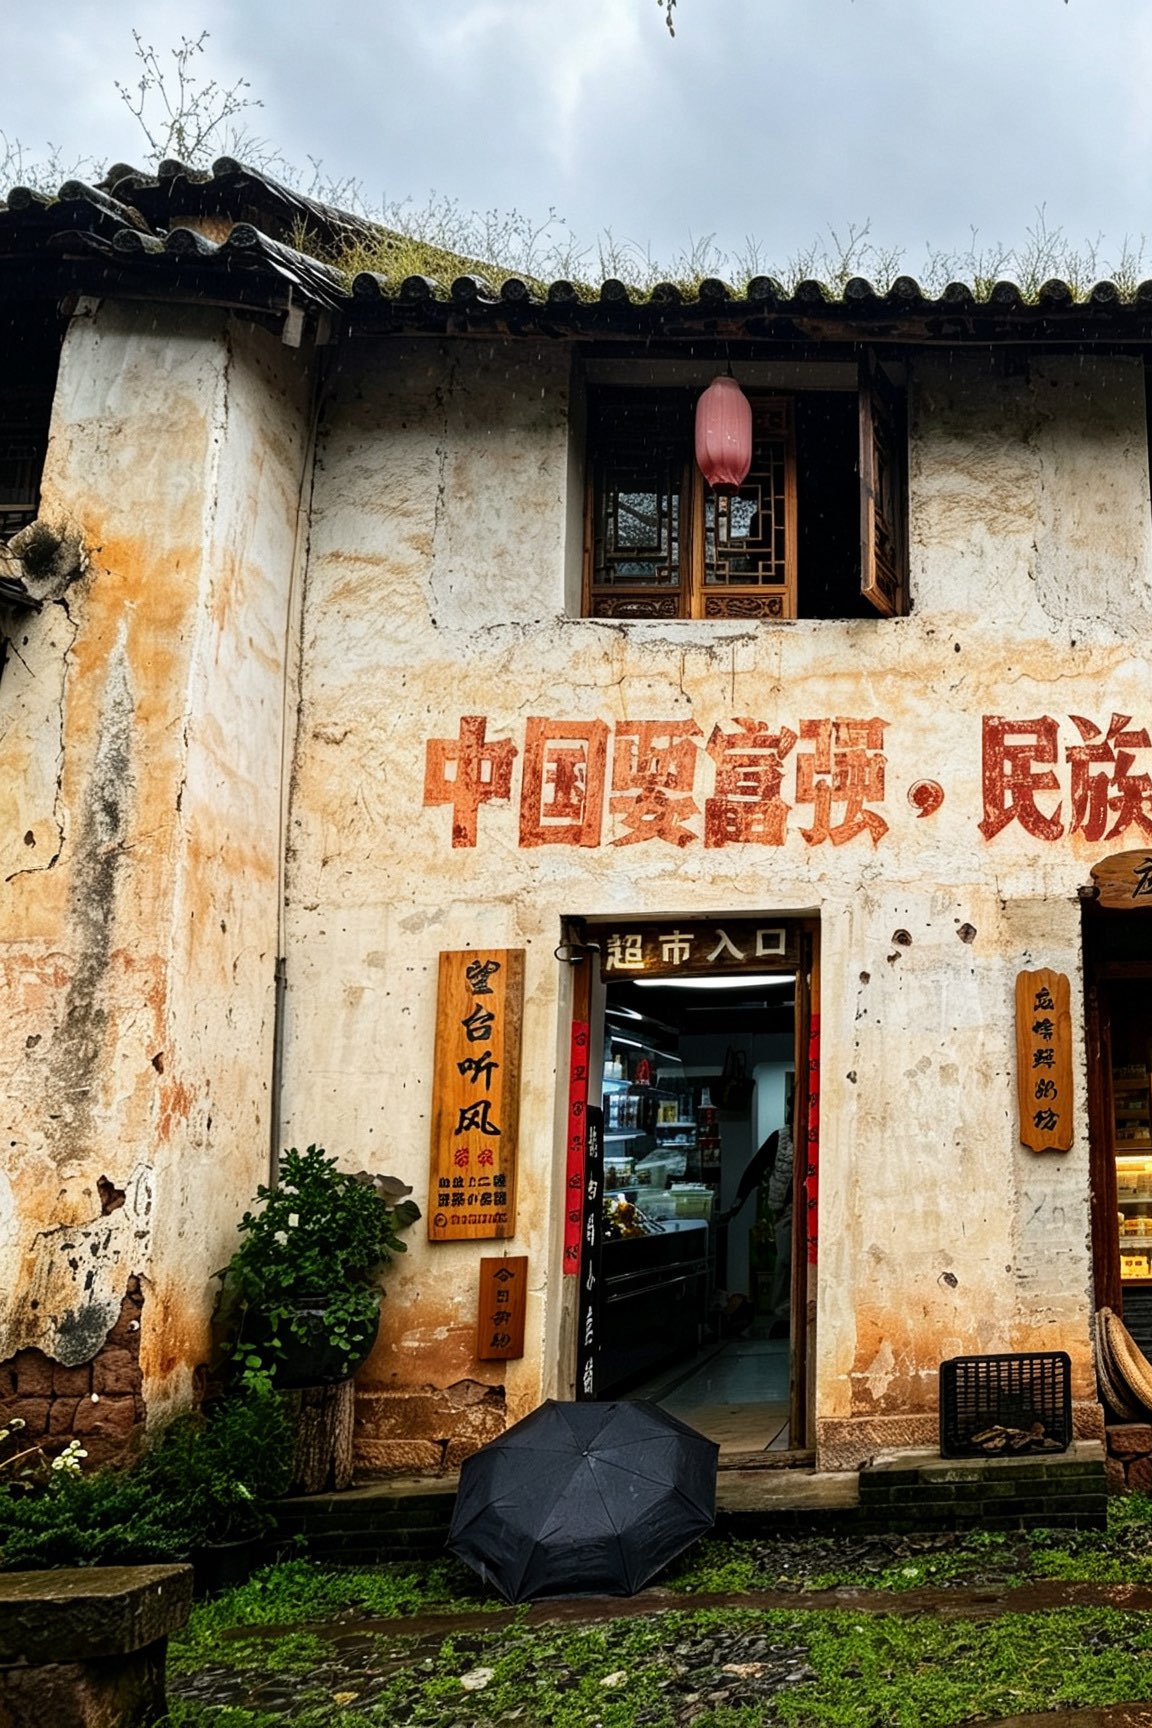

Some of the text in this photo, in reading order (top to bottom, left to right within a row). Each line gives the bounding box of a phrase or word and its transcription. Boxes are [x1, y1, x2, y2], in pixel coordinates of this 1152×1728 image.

[605, 928, 787, 971] 超市入口
[454, 959, 502, 1136] 望台听风
